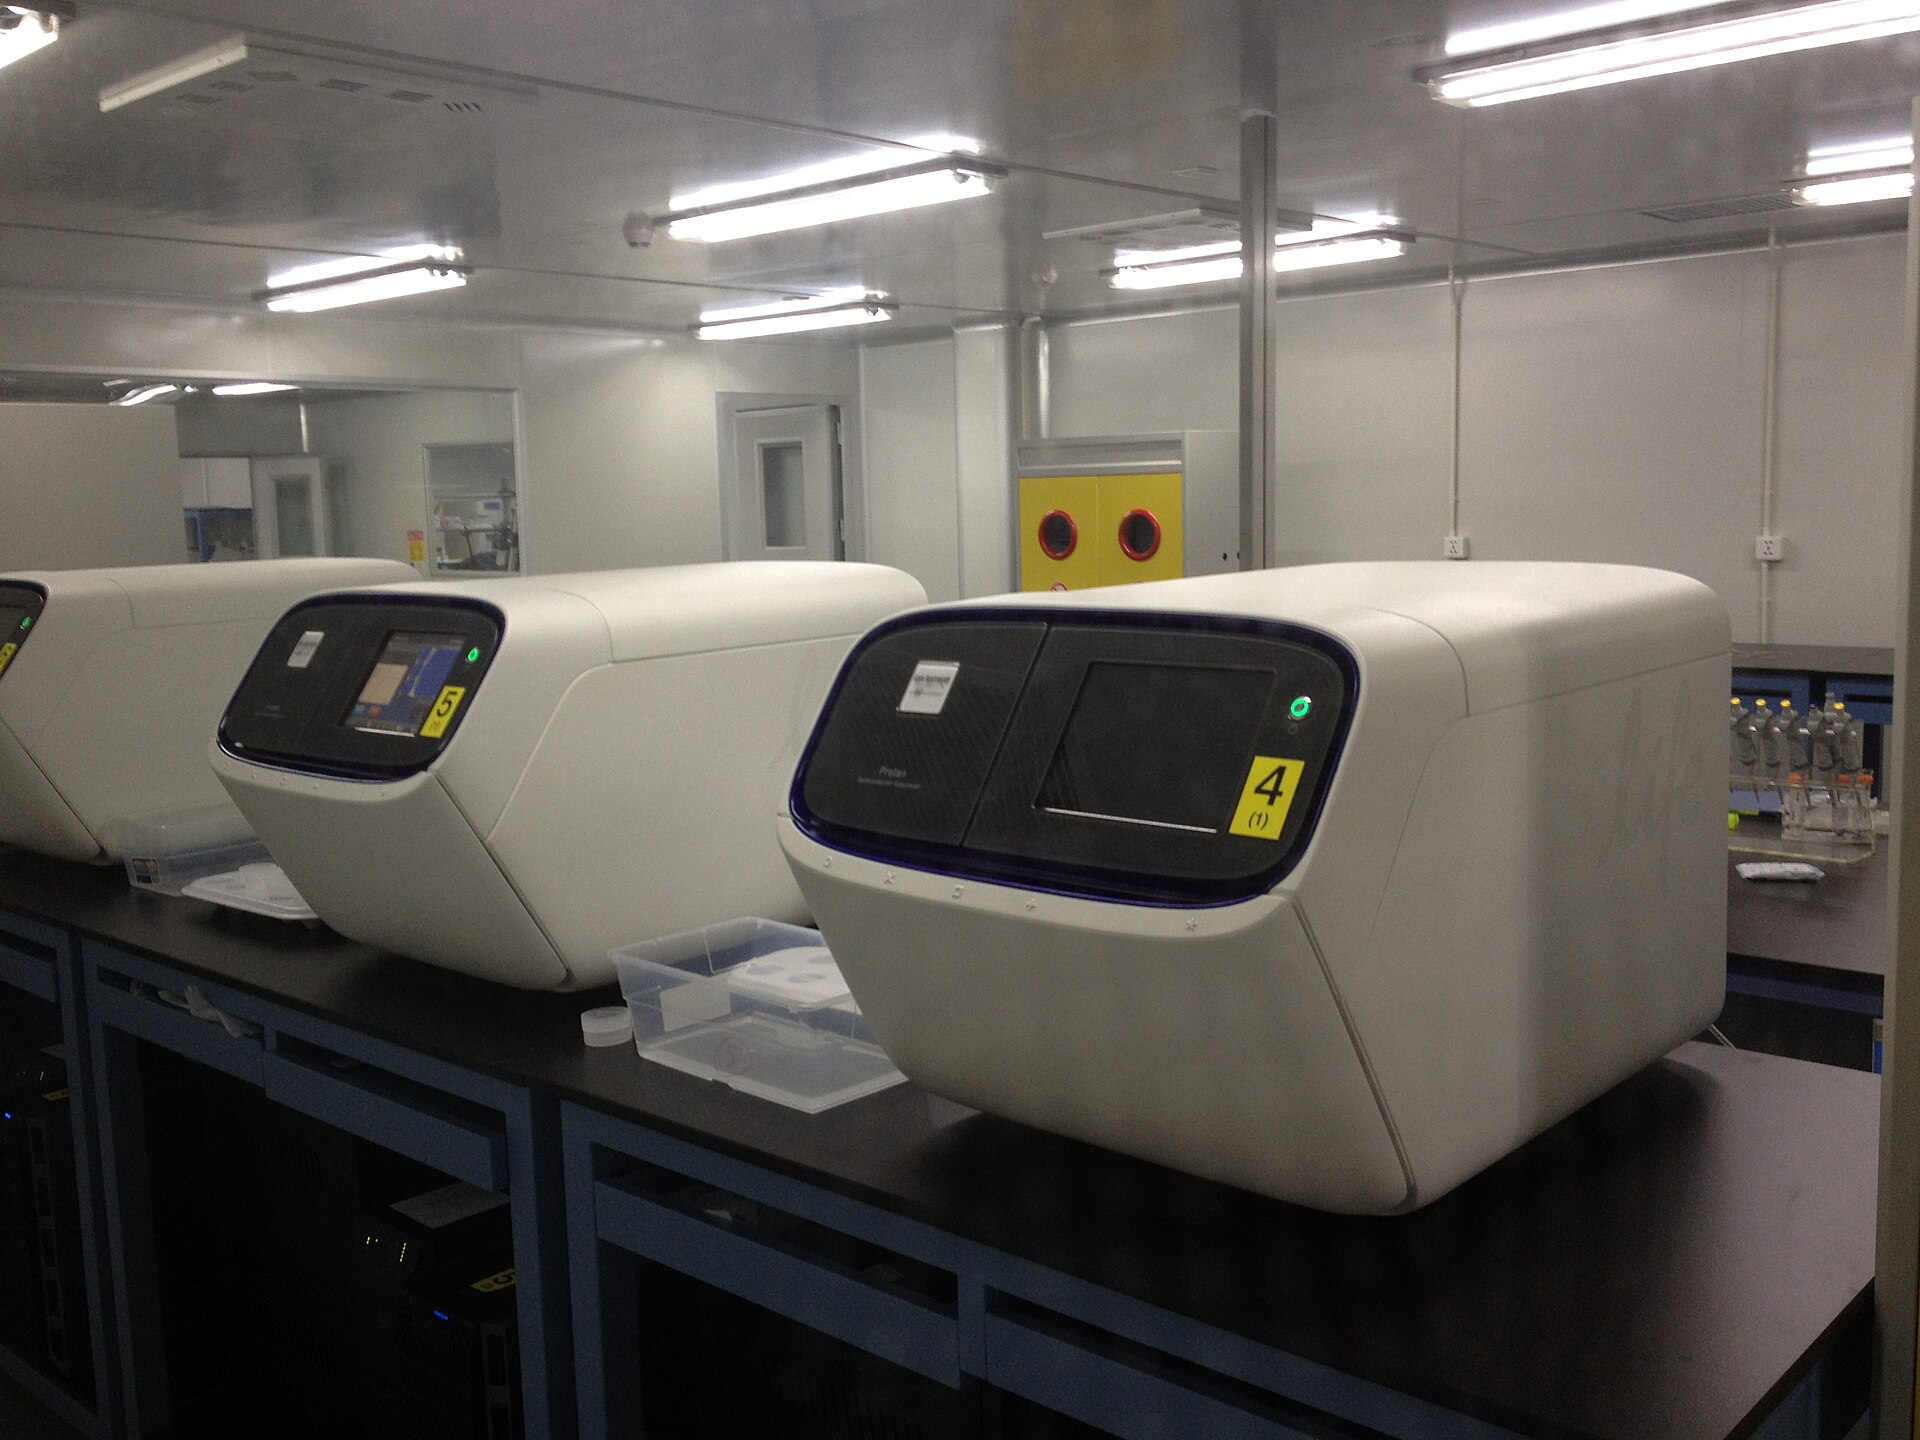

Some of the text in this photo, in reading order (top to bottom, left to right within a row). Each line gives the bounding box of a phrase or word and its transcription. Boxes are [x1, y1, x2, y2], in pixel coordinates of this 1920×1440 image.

[437, 691, 458, 717] 5
[1254, 765, 1287, 806] 4
[1248, 811, 1269, 830] (1)
